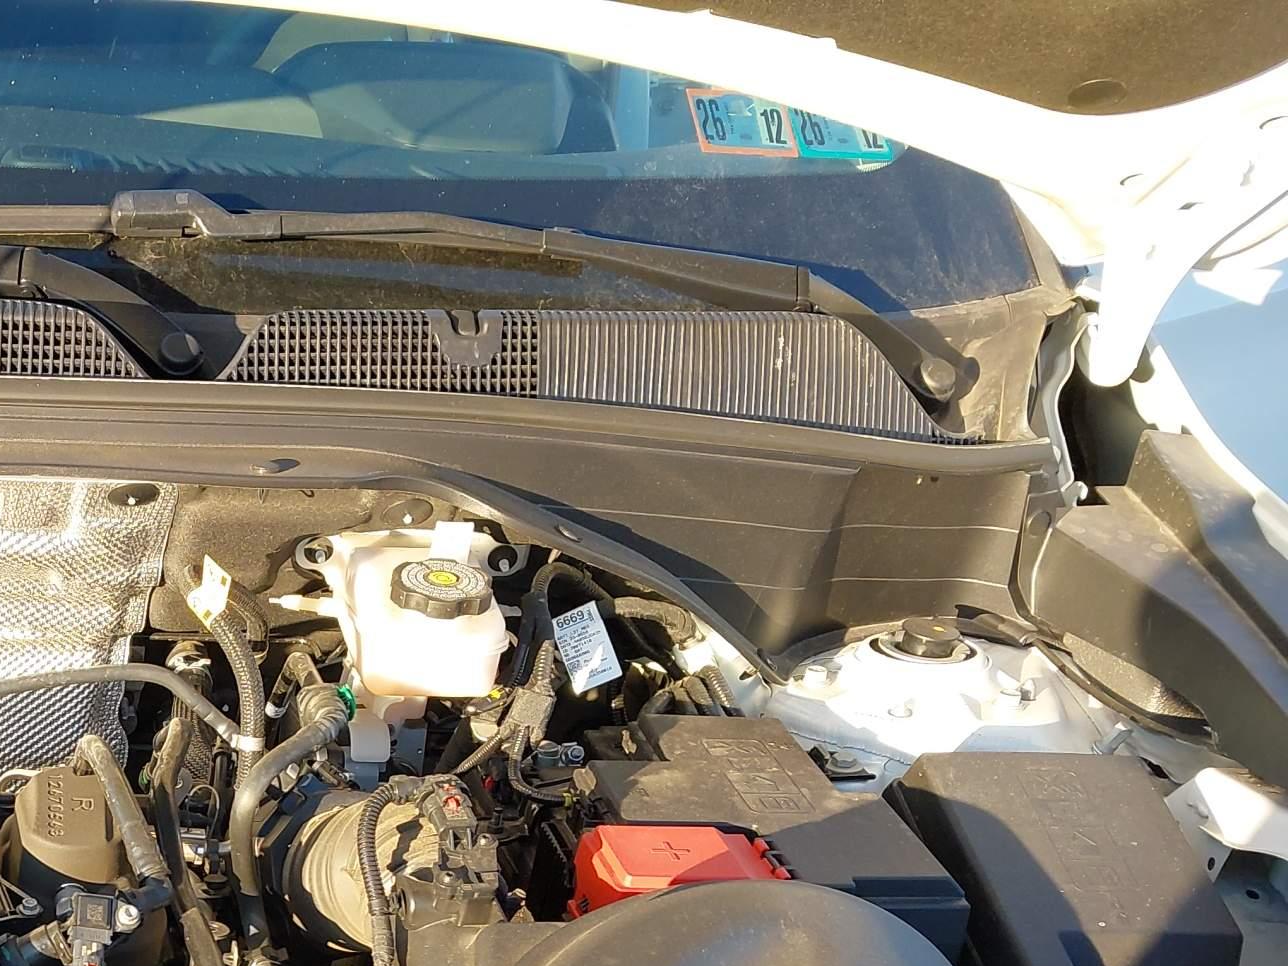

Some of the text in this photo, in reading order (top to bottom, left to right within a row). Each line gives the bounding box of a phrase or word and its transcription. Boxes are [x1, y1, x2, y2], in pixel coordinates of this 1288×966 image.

[695, 98, 727, 141] 26
[760, 108, 788, 145] 12
[556, 610, 585, 628] 6669
[71, 797, 95, 812] R
